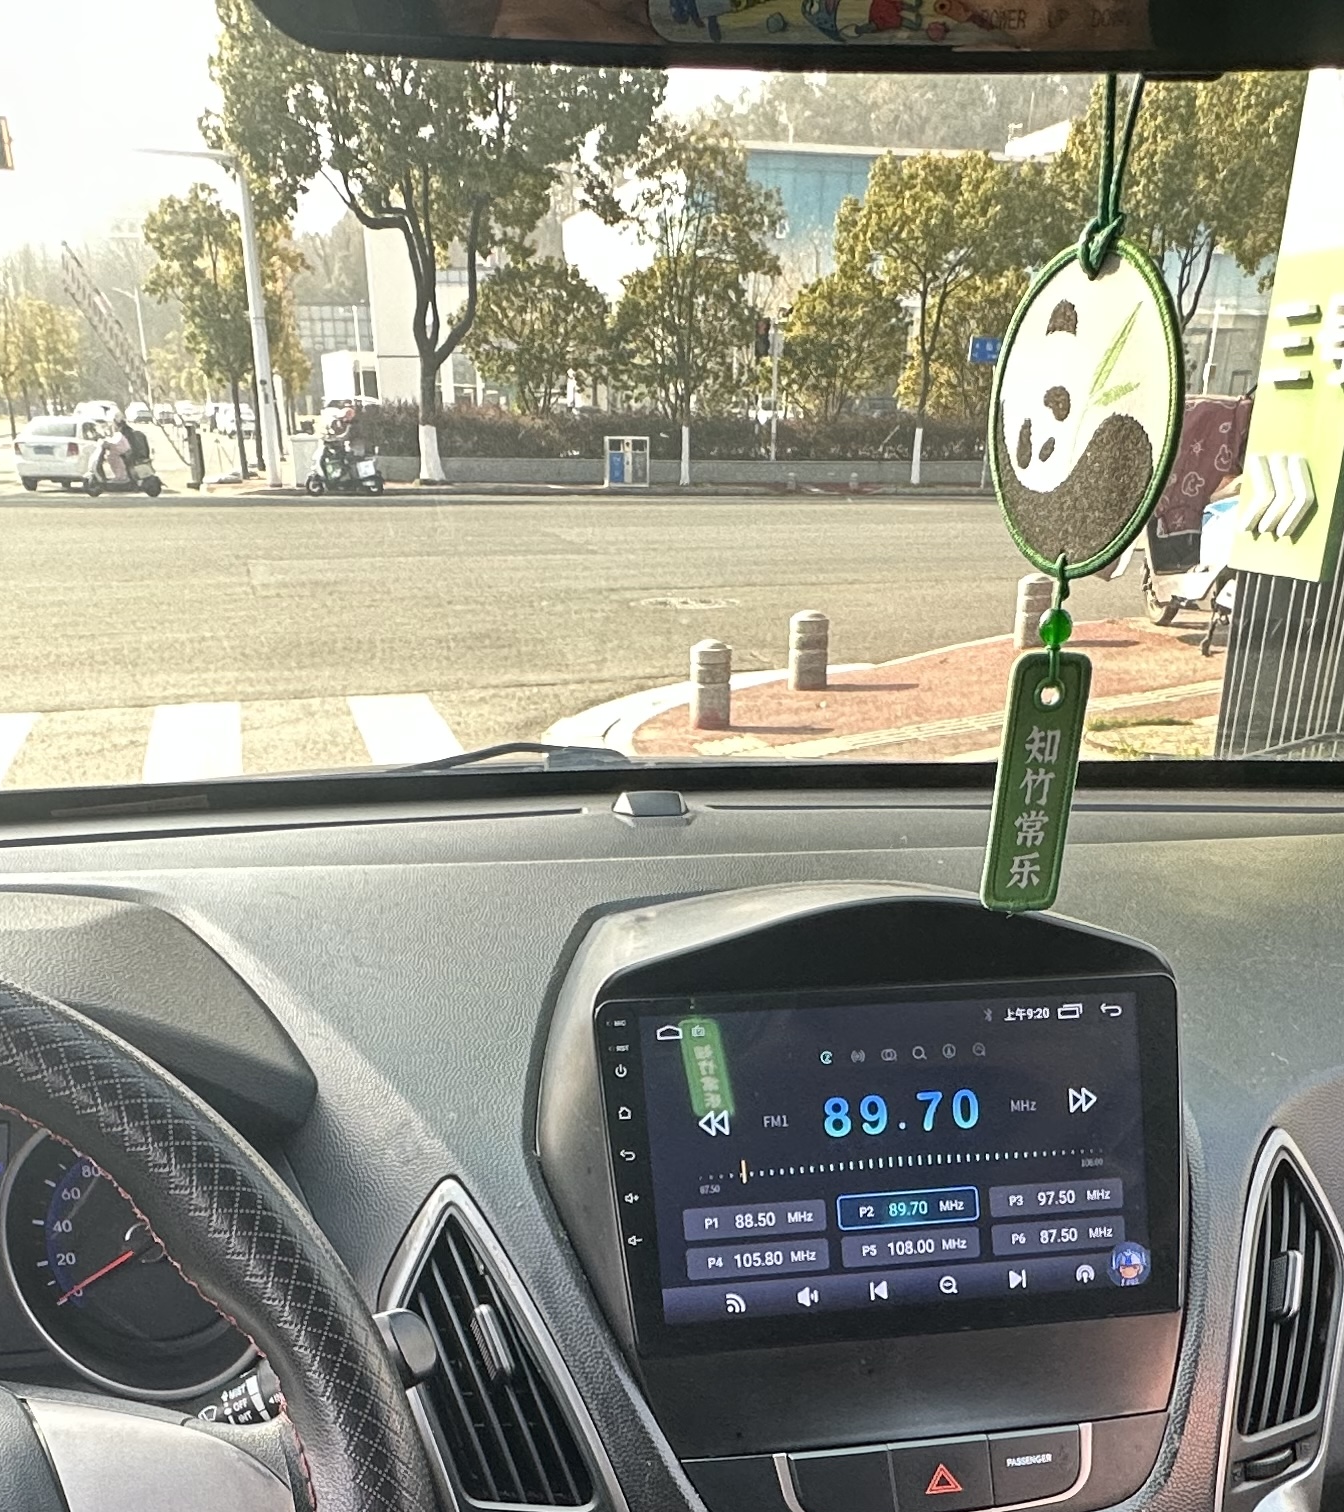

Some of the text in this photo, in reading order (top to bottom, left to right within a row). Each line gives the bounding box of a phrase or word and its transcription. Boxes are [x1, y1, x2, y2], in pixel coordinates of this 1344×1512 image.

[1006, 724, 1063, 891] 知竹常乐
[823, 1088, 980, 1138] 89.70
[1010, 1100, 1037, 1113] MHz
[763, 1115, 789, 1129] FM1
[61, 1187, 81, 1201] 60
[1009, 1189, 1111, 1207] P3 97.50 MHz
[859, 1199, 965, 1218] P2 89.70 MHz
[53, 1220, 73, 1233] 40
[704, 1211, 814, 1229] P1 88.50 MHz
[1011, 1226, 1113, 1245] P6 87.50 MHz
[862, 1238, 967, 1257] P5 108.00 MHz
[57, 1252, 76, 1267] 20
[707, 1250, 817, 1269] P4 105.80 MHz
[233, 1398, 248, 1412] OFF
